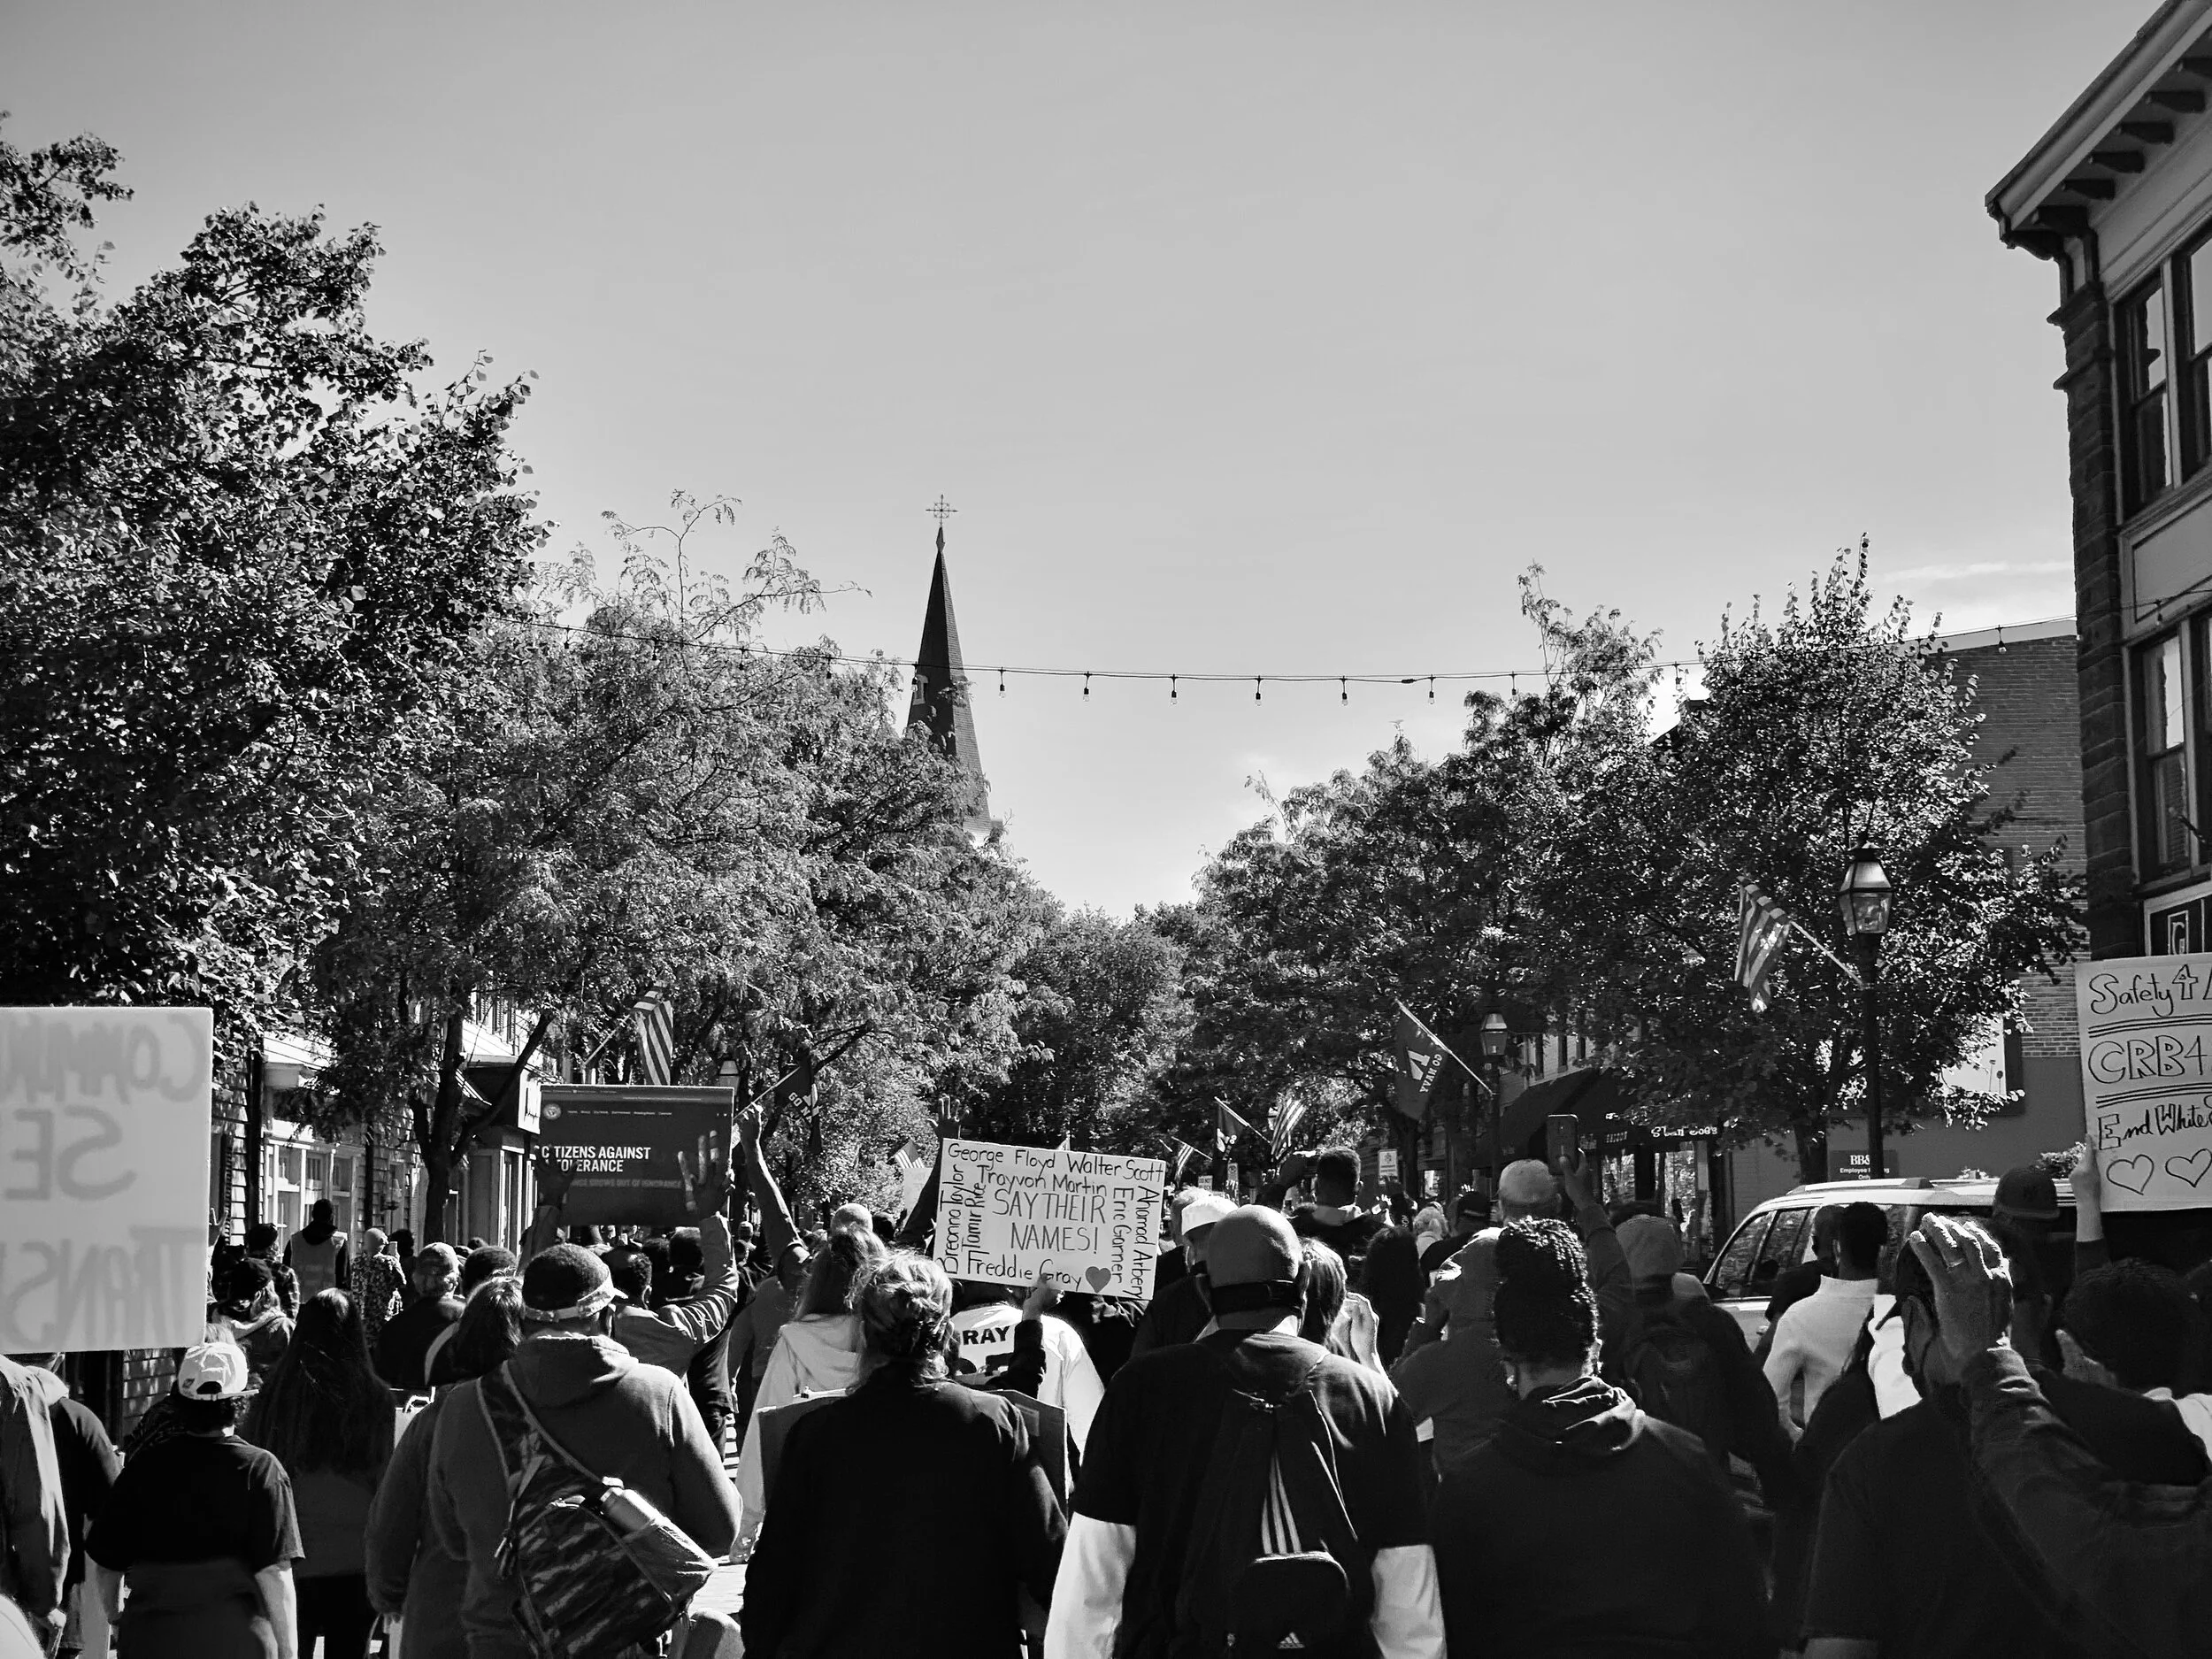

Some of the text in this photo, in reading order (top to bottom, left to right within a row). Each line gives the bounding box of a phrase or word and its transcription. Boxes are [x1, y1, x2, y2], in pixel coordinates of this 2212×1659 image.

[2088, 972, 2173, 1018] Safety
[2172, 964, 2198, 1001] 4
[787, 1092, 803, 1107] GO
[2098, 1109, 2154, 1151] End
[2154, 1102, 2209, 1136] White
[541, 1146, 651, 1160] CTIZENS AGAINST
[543, 1159, 624, 1172] OERANCE
[948, 1142, 1164, 1183] George Floyd Walter Scott
[976, 1164, 1107, 1197] Trayvon Martin
[936, 1164, 972, 1275] Breanna Taylor
[961, 1182, 987, 1252] Tamir Rice
[992, 1189, 1106, 1225] SAY THEIR
[1010, 1222, 1099, 1255] NAMES!
[1110, 1187, 1134, 1284] Eric Garner
[966, 1250, 1082, 1292] Freddie Gray
[1122, 1249, 1153, 1300] Arbery
